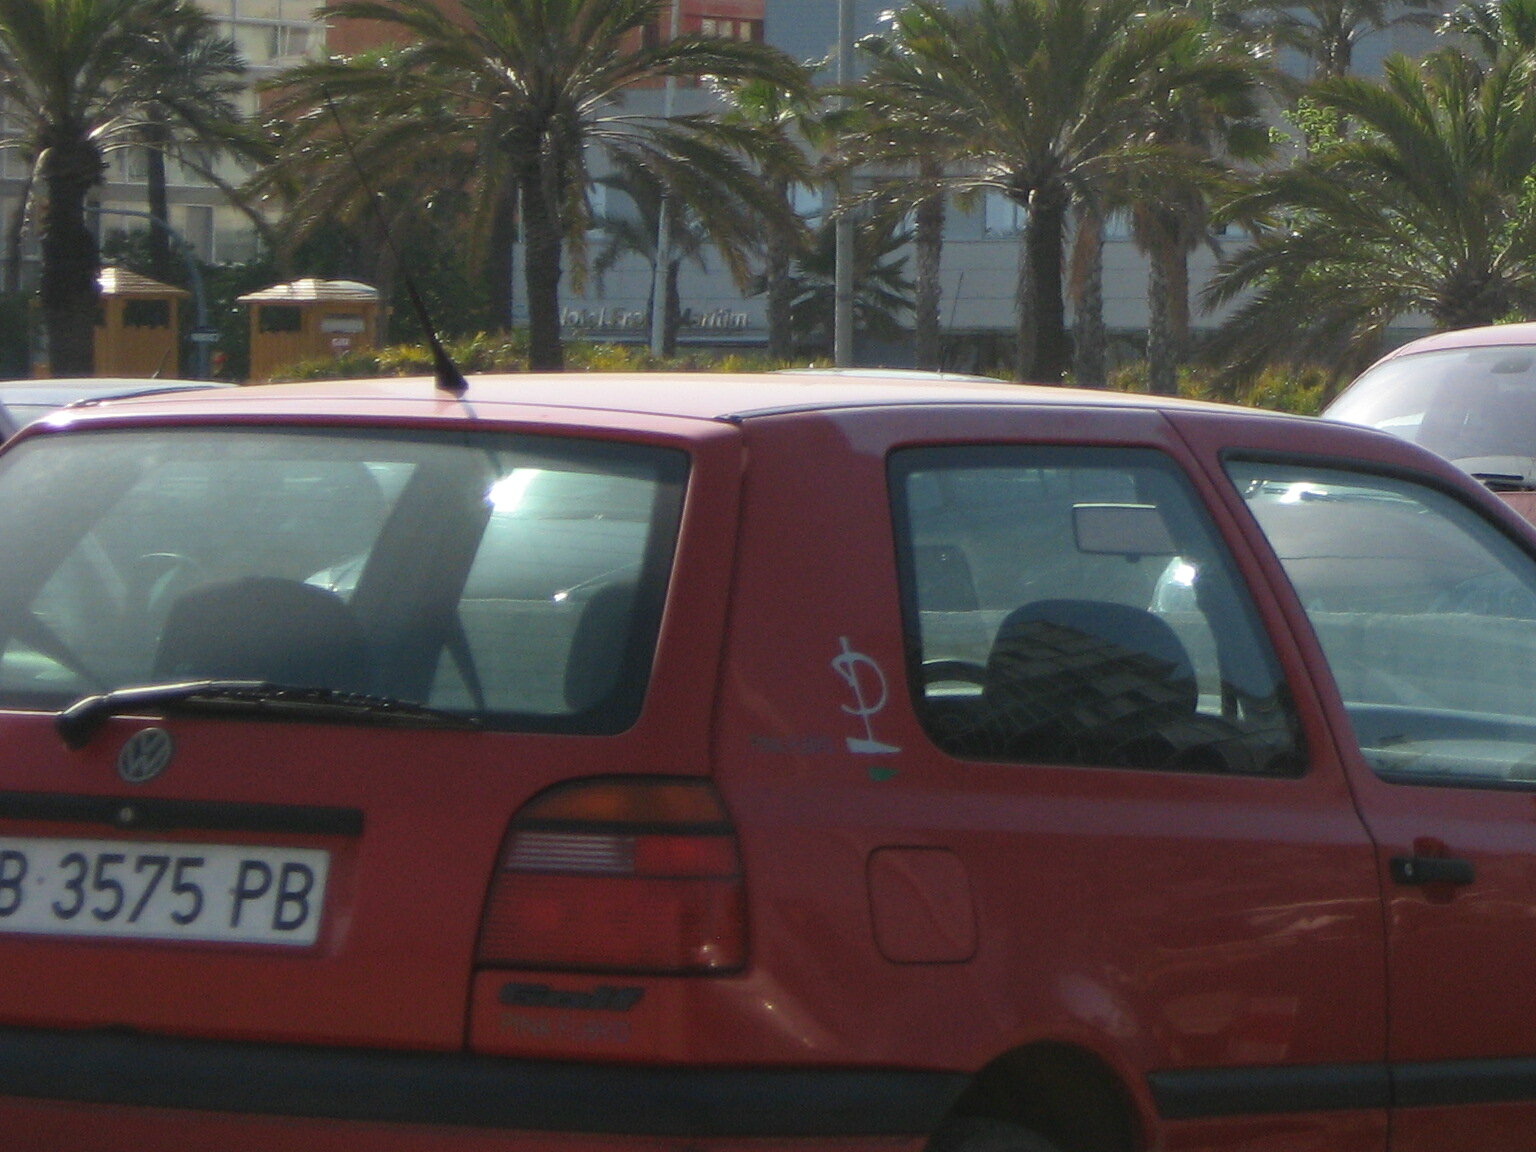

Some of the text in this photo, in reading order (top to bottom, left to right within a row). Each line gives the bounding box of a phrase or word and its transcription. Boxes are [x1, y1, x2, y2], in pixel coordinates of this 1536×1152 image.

[0, 849, 314, 931] B 3575 PB
